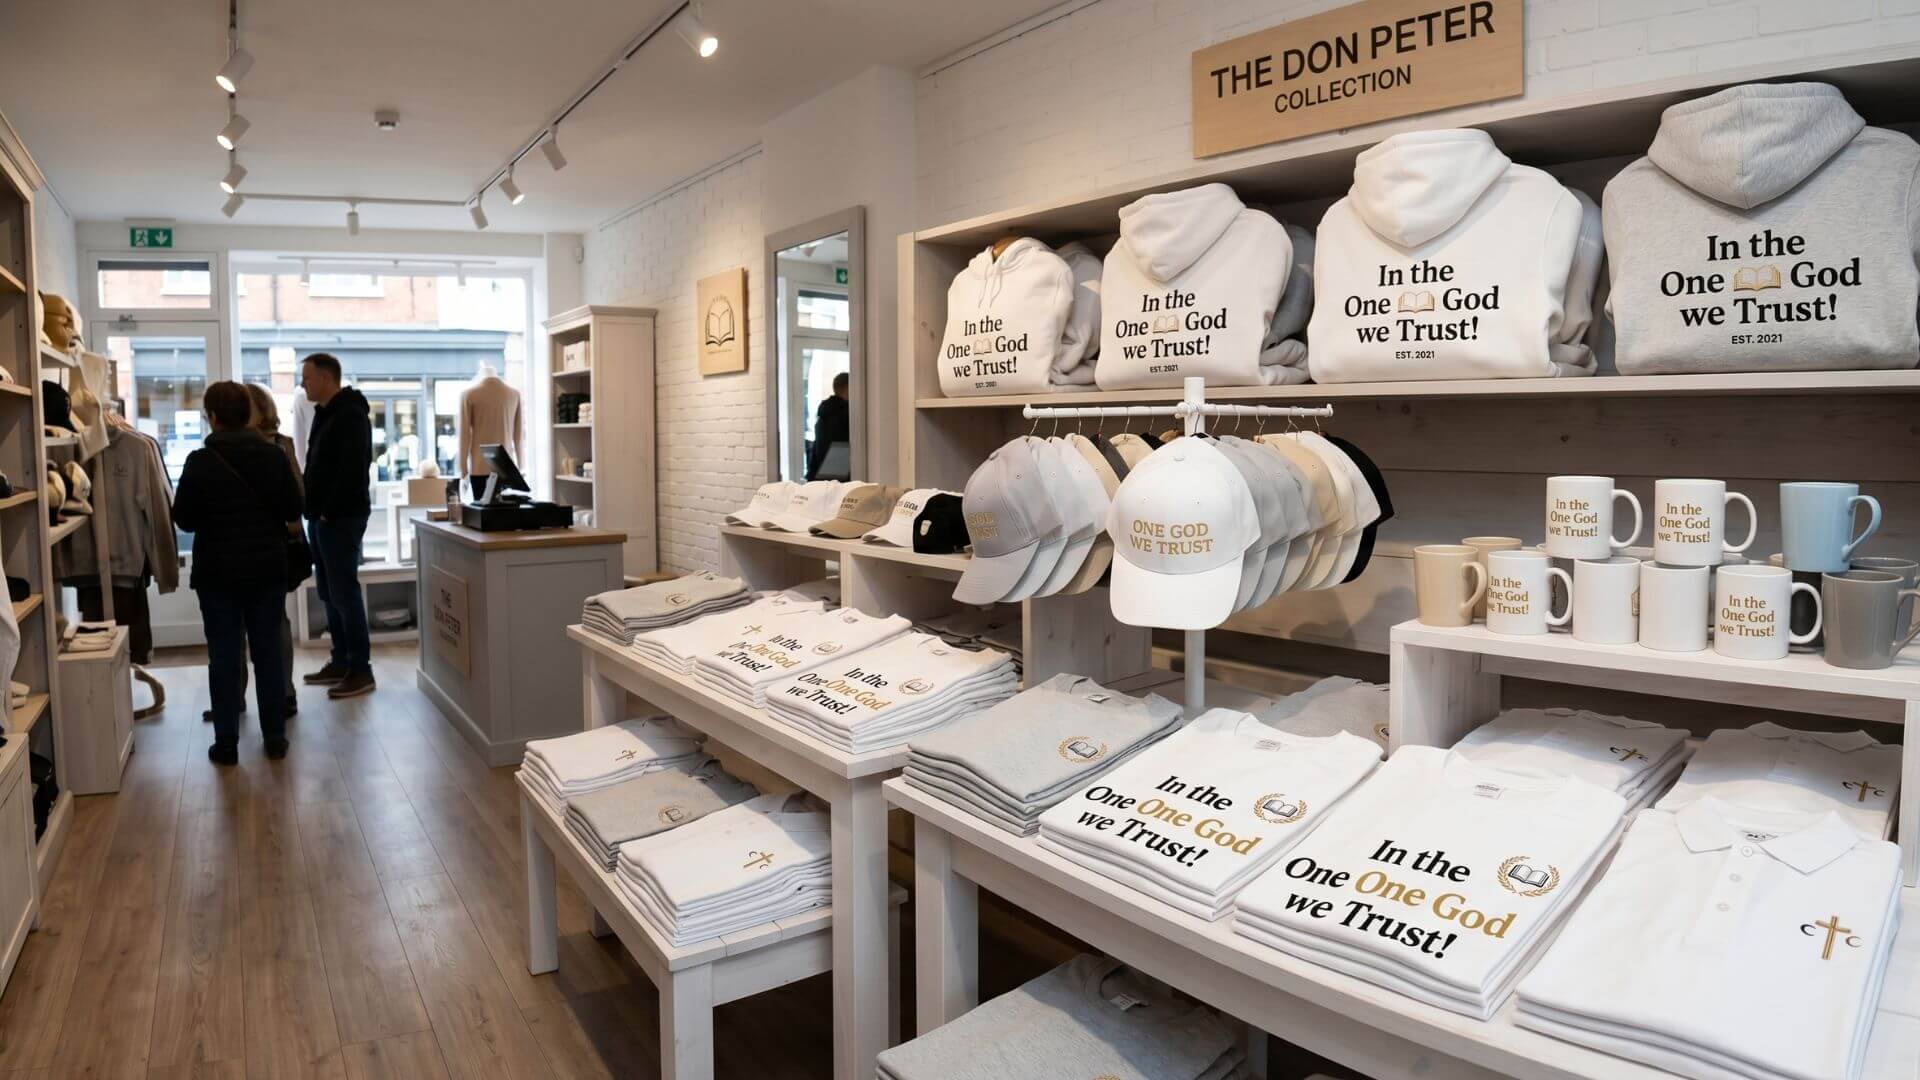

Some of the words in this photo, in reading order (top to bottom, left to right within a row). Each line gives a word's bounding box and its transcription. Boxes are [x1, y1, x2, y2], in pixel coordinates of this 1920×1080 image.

[1210, 55, 1273, 98] THE
[1283, 32, 1358, 81] DON
[1371, 0, 1495, 59] PETER
[1275, 64, 1411, 113] COLLECTION
[1706, 235, 1741, 261] In
[1749, 229, 1805, 258] the
[1377, 264, 1404, 287] In
[1410, 259, 1454, 284] the
[1660, 271, 1725, 297] One
[1790, 257, 1862, 288] God
[1141, 294, 1160, 312] In
[1165, 289, 1195, 309] the
[1344, 295, 1391, 317] One
[1442, 285, 1500, 311] God
[1679, 306, 1725, 327] we
[1733, 293, 1837, 324] Trust!
[964, 320, 976, 336] In
[979, 315, 1003, 333] the
[1115, 320, 1149, 338] One
[1185, 308, 1227, 331] God
[1356, 325, 1390, 344] we
[1396, 315, 1479, 342] Trust!
[947, 343, 971, 359] One
[995, 333, 1028, 353] God
[1123, 344, 1147, 360] we
[1151, 335, 1210, 358] Trust!
[1731, 335, 1754, 345] EST.
[1757, 334, 1783, 344] 2021
[1395, 351, 1414, 359] EST.
[1415, 350, 1435, 359] 2021
[953, 365, 971, 378] we
[973, 356, 1017, 376] Trust!
[1556, 498, 1566, 509] In
[1569, 499, 1589, 510] the
[1666, 502, 1678, 514] In
[1681, 503, 1702, 515] the
[1550, 510, 1570, 523] One
[1573, 512, 1598, 524] God
[1659, 516, 1682, 528] One
[1684, 517, 1710, 529] God
[1133, 519, 1165, 538] ONE
[1170, 523, 1209, 539] GOD
[1549, 526, 1561, 536] we
[1563, 525, 1598, 537] Trust!
[1658, 532, 1671, 541] we
[1673, 531, 1710, 543] Trust!
[1130, 534, 1153, 553] WE
[1156, 538, 1214, 555] TRUST
[1491, 576, 1500, 587] In
[1503, 577, 1522, 588] the
[1505, 590, 1529, 602] God
[1729, 594, 1741, 607] In
[1744, 596, 1766, 609] the
[1496, 602, 1529, 615] Trust!
[1722, 608, 1745, 621] One
[1748, 610, 1775, 623] God
[1720, 624, 1734, 634] we
[1736, 624, 1775, 637] Trust!
[780, 639, 803, 651] the
[728, 651, 773, 673] Trust!
[768, 651, 801, 669] God
[843, 668, 864, 679] In
[861, 674, 888, 688] the
[785, 686, 809, 696] we
[805, 689, 858, 715] Trust!
[797, 673, 828, 686] One
[825, 679, 859, 696] One
[854, 691, 892, 711] God
[1155, 775, 1187, 795] In
[1186, 786, 1233, 811] the
[1085, 786, 1136, 810] One
[1136, 798, 1193, 827] One
[1194, 818, 1263, 855] God
[1077, 811, 1115, 831] we
[1116, 818, 1209, 867] Trust!
[1368, 839, 1408, 866] In
[1411, 850, 1471, 883] the
[1285, 857, 1350, 888] One
[1354, 871, 1426, 907] One
[1432, 893, 1517, 939] God
[1284, 893, 1334, 919] we
[1339, 900, 1458, 959] Trust!
